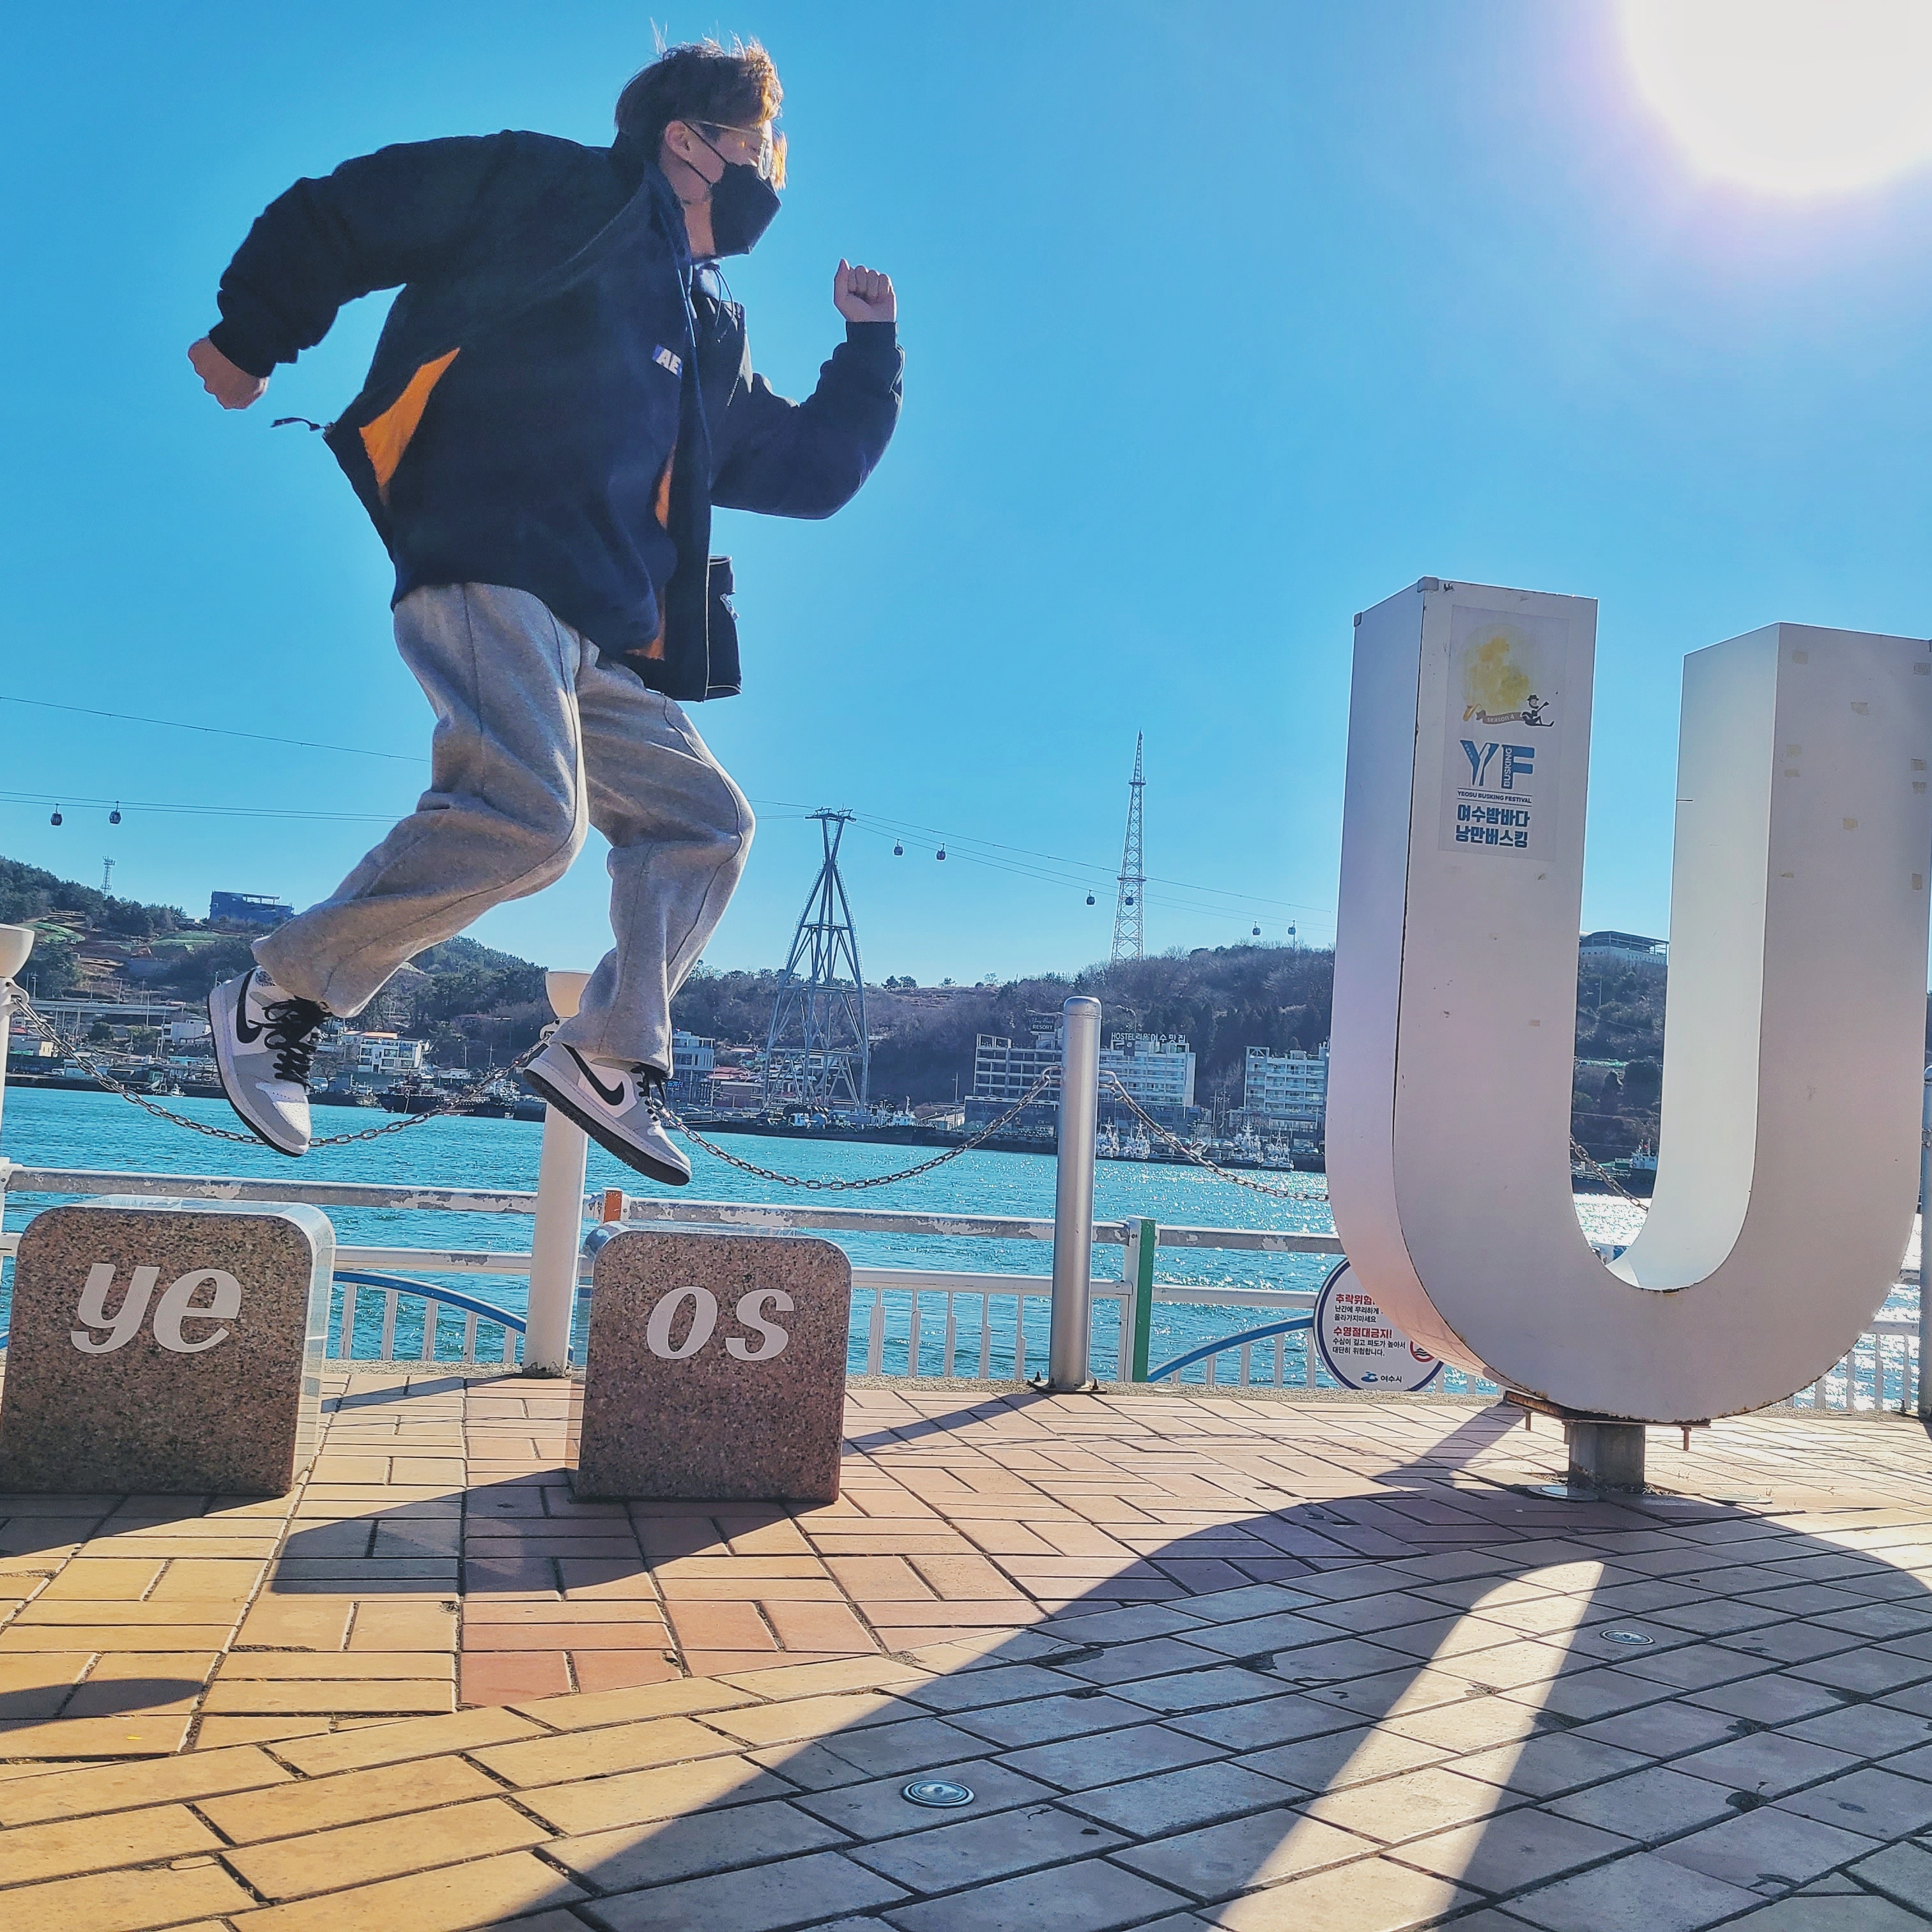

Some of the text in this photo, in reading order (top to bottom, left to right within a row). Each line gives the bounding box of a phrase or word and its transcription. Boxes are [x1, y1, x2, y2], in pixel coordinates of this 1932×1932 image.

[1503, 747, 1512, 787] BUSKING
[1457, 804, 1530, 827] 여수밤바다
[1455, 825, 1528, 848] 낭만버스킹
[1111, 1032, 1135, 1041] HOSTEL
[70, 1262, 242, 1354] ye
[1335, 1305, 1379, 1315] 난간에 무리하게
[647, 1286, 795, 1361] os
[1334, 1313, 1377, 1322] 올라가지마세요
[1333, 1326, 1392, 1339] 수영절대금지!
[1332, 1337, 1351, 1346] 수심이
[1367, 1339, 1386, 1348] 파도가
[1388, 1340, 1406, 1349] 높아서
[1332, 1346, 1385, 1356] 대단히 위험합니다.
[1380, 1375, 1402, 1383] 여수시
